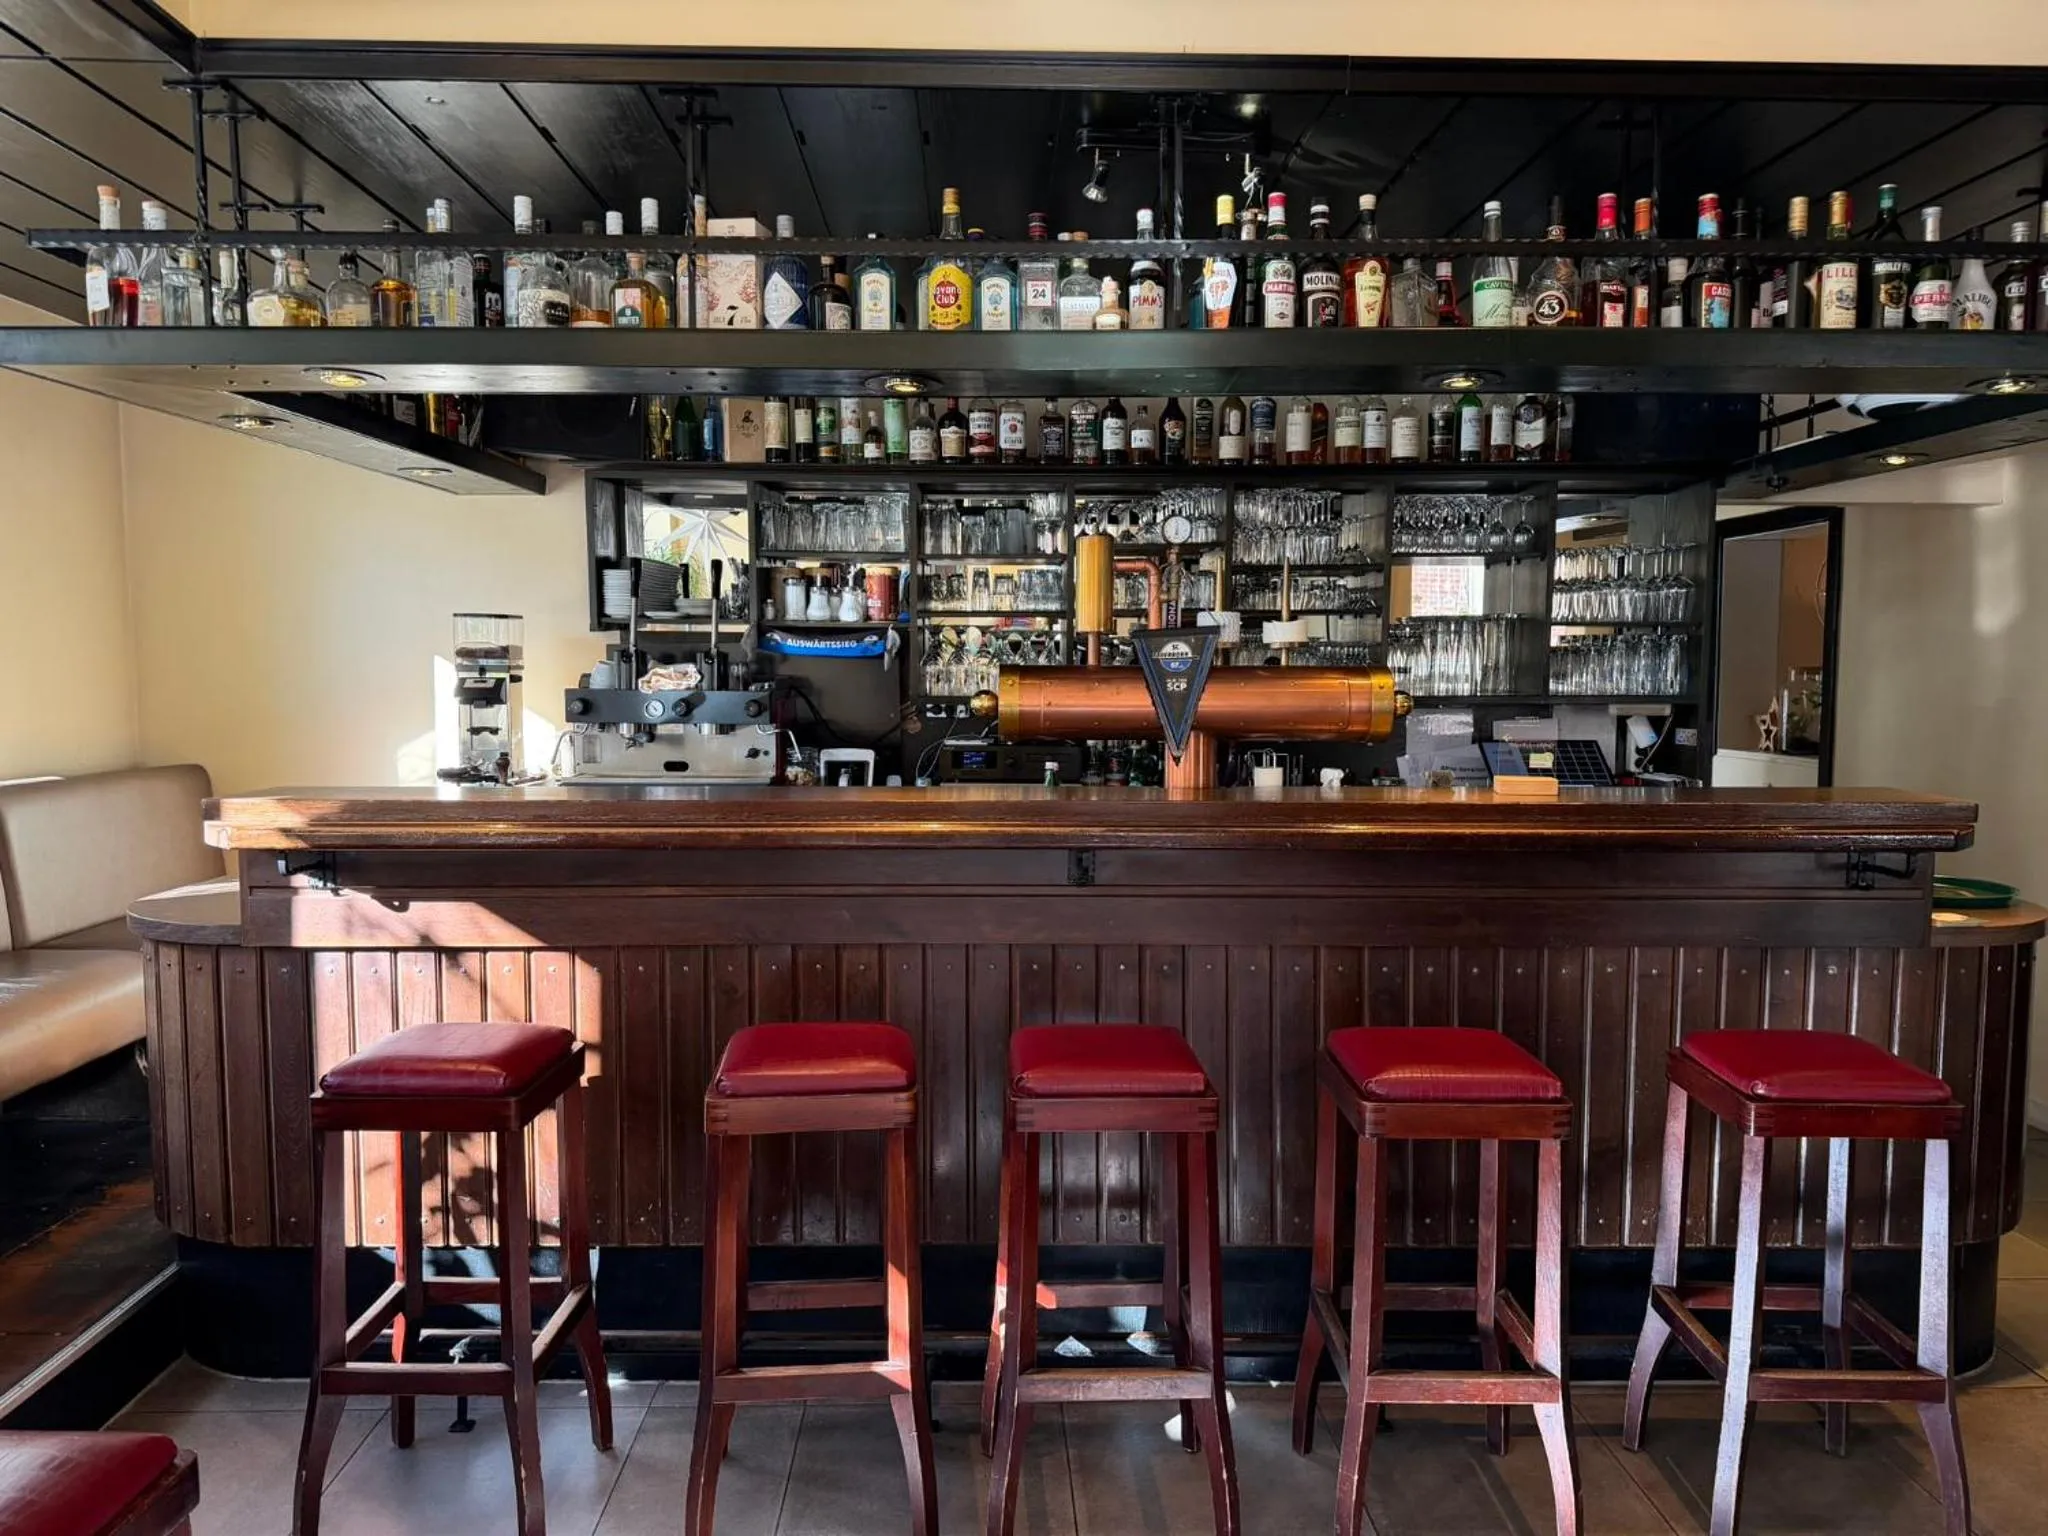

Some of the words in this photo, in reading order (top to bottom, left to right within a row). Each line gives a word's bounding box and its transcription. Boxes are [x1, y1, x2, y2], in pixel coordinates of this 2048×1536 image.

[936, 294, 955, 304] Club
[1031, 289, 1046, 299] 24
[1538, 301, 1560, 315] 43
[1166, 682, 1188, 691] SCP
